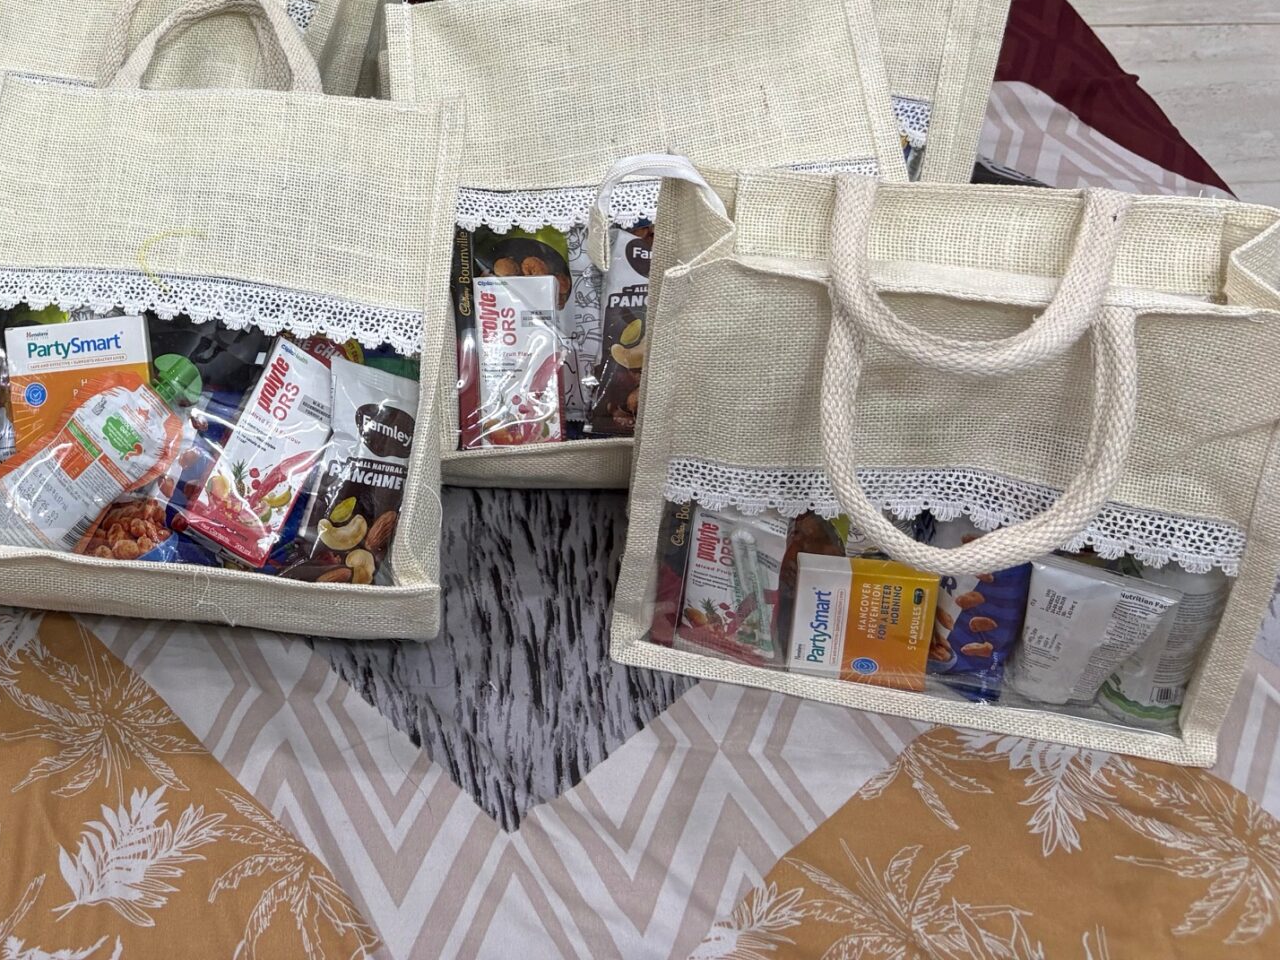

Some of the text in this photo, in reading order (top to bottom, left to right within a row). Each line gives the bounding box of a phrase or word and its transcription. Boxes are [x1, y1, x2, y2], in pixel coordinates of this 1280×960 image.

[458, 231, 470, 284] Bournville
[27, 333, 122, 359] PartySmart
[501, 307, 517, 346] ORS
[257, 356, 290, 414] prolyte
[272, 382, 300, 421] ORS
[363, 414, 412, 447] Farmley
[372, 463, 403, 475] NATURAL
[695, 521, 721, 563] prolyte
[857, 583, 872, 631] HANGOVER
[867, 584, 881, 639] PREVENTION
[880, 584, 892, 615] BETTER
[890, 585, 902, 625] MORNING
[1121, 593, 1154, 606] Nutrition
[807, 590, 831, 663] PartySmart
[878, 625, 887, 640] FOR
[908, 607, 922, 645] CAPSULES
